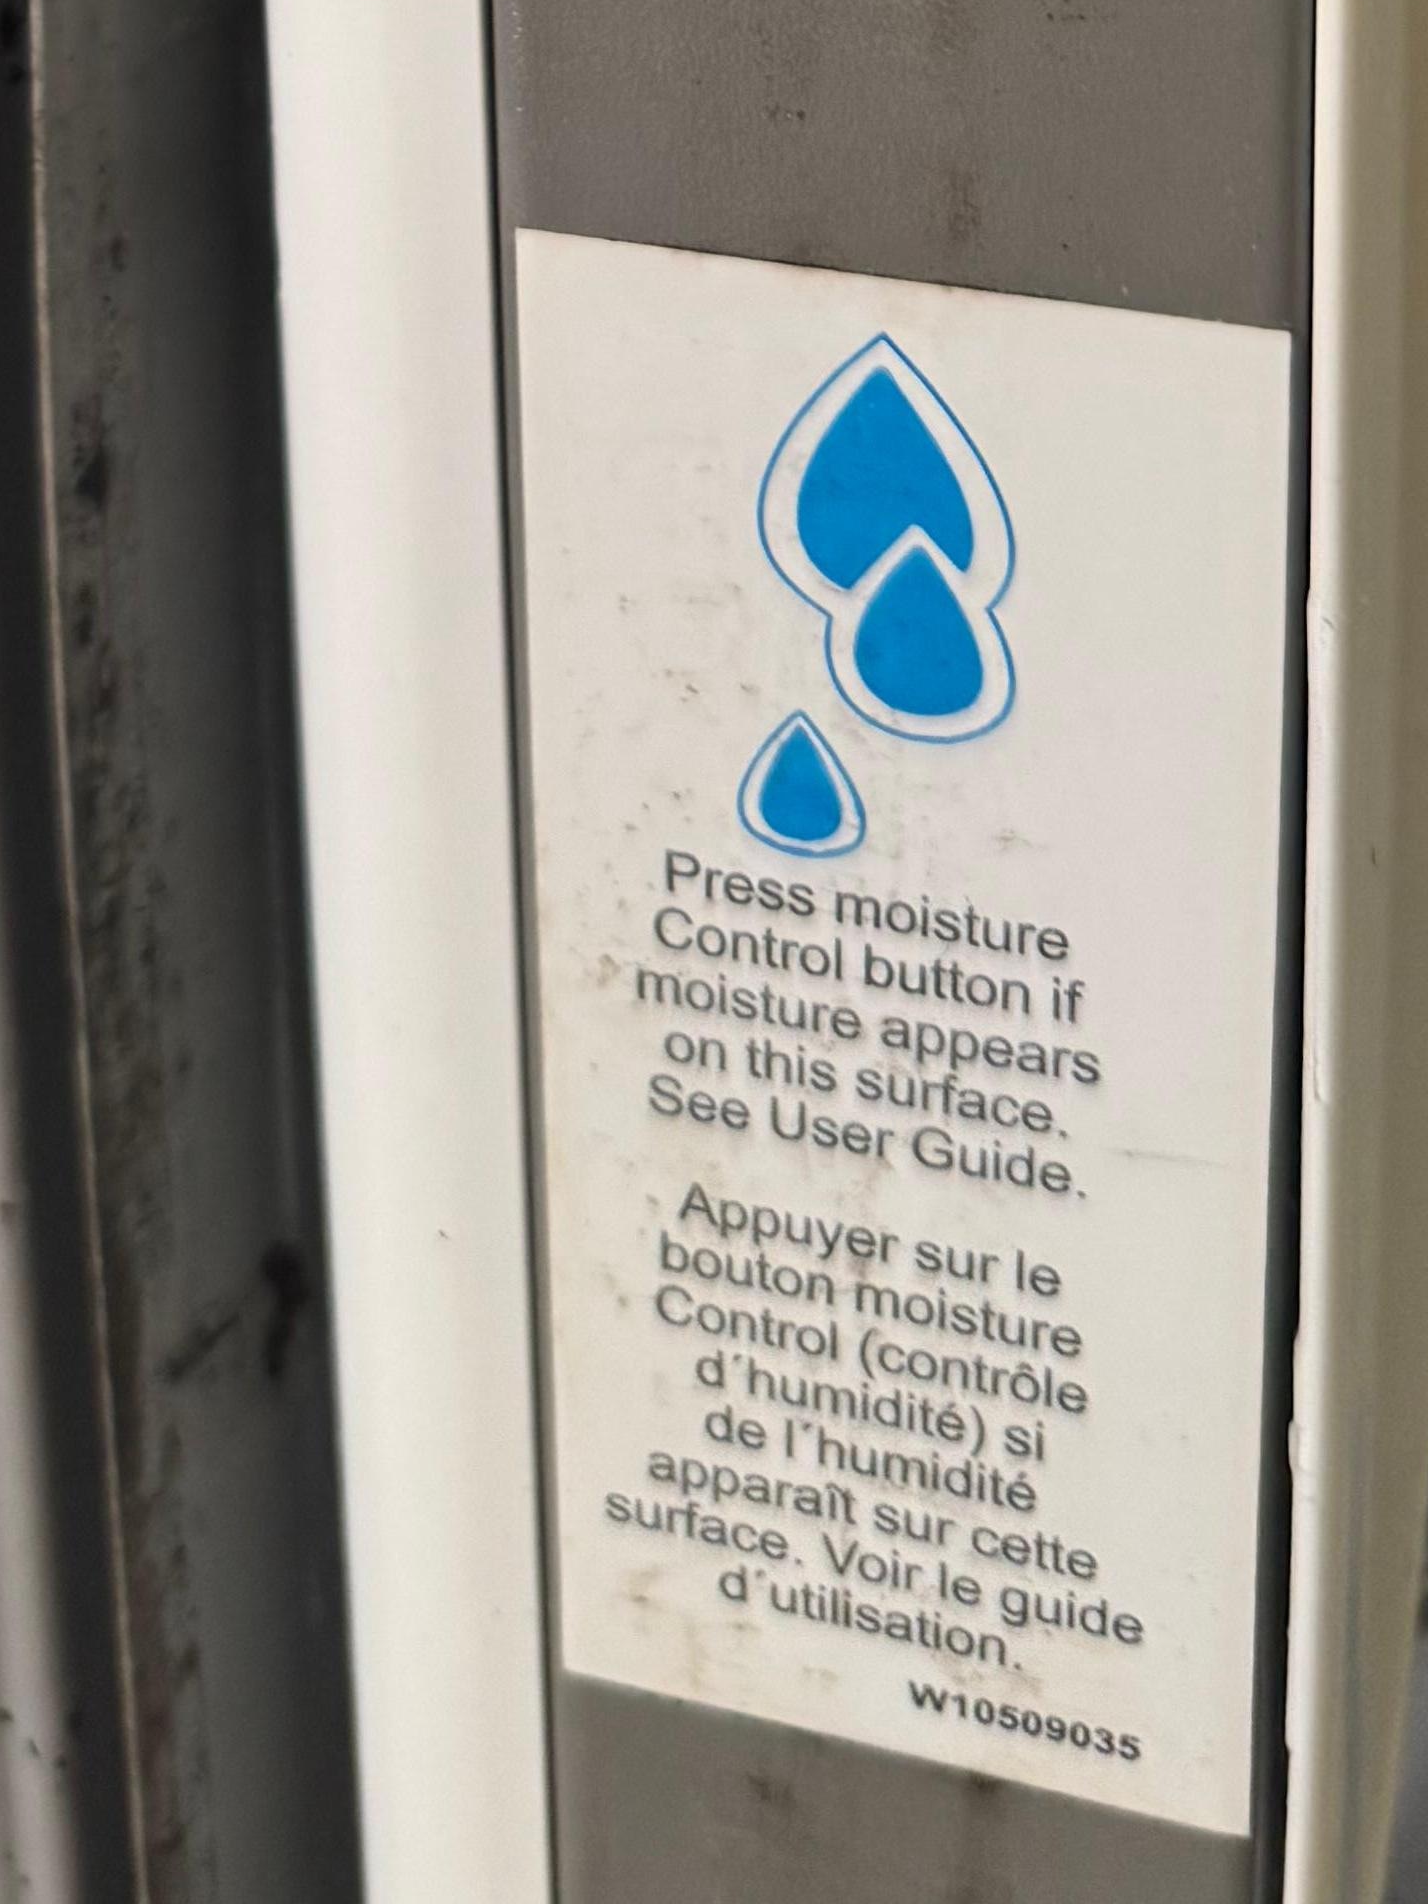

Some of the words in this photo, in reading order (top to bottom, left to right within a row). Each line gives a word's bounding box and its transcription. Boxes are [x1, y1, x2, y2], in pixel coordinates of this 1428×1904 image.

[653, 906, 844, 983] Control
[863, 943, 1031, 1018] button
[1052, 975, 1086, 1025] if
[664, 849, 817, 920] Press
[834, 891, 1070, 963] moisture
[636, 968, 864, 1042] moisture
[879, 1016, 1102, 1088] appears
[663, 1031, 728, 1073] on
[745, 1038, 838, 1095] this
[855, 1068, 1068, 1140] surface.
[648, 1073, 751, 1133] See
[769, 1095, 895, 1161] User
[910, 1126, 1086, 1200] Guide.
[659, 1230, 837, 1307] bouton
[853, 1280, 1083, 1361] moisture
[677, 1182, 900, 1267] Appuyer
[914, 1241, 1000, 1286] sur
[1015, 1249, 1063, 1299] le
[653, 1284, 840, 1363] Control
[858, 1327, 1089, 1417] (contrôle
[704, 1404, 768, 1452] de
[1003, 1420, 1045, 1463] si
[605, 1492, 803, 1566] surface.
[822, 1532, 923, 1592] Voir
[938, 1561, 983, 1609] le
[999, 1586, 1144, 1646] guide
[647, 1452, 857, 1526] apparaît
[873, 1503, 956, 1547] sur
[971, 1526, 1099, 1583] cette
[907, 1680, 1142, 1763] W10509035
